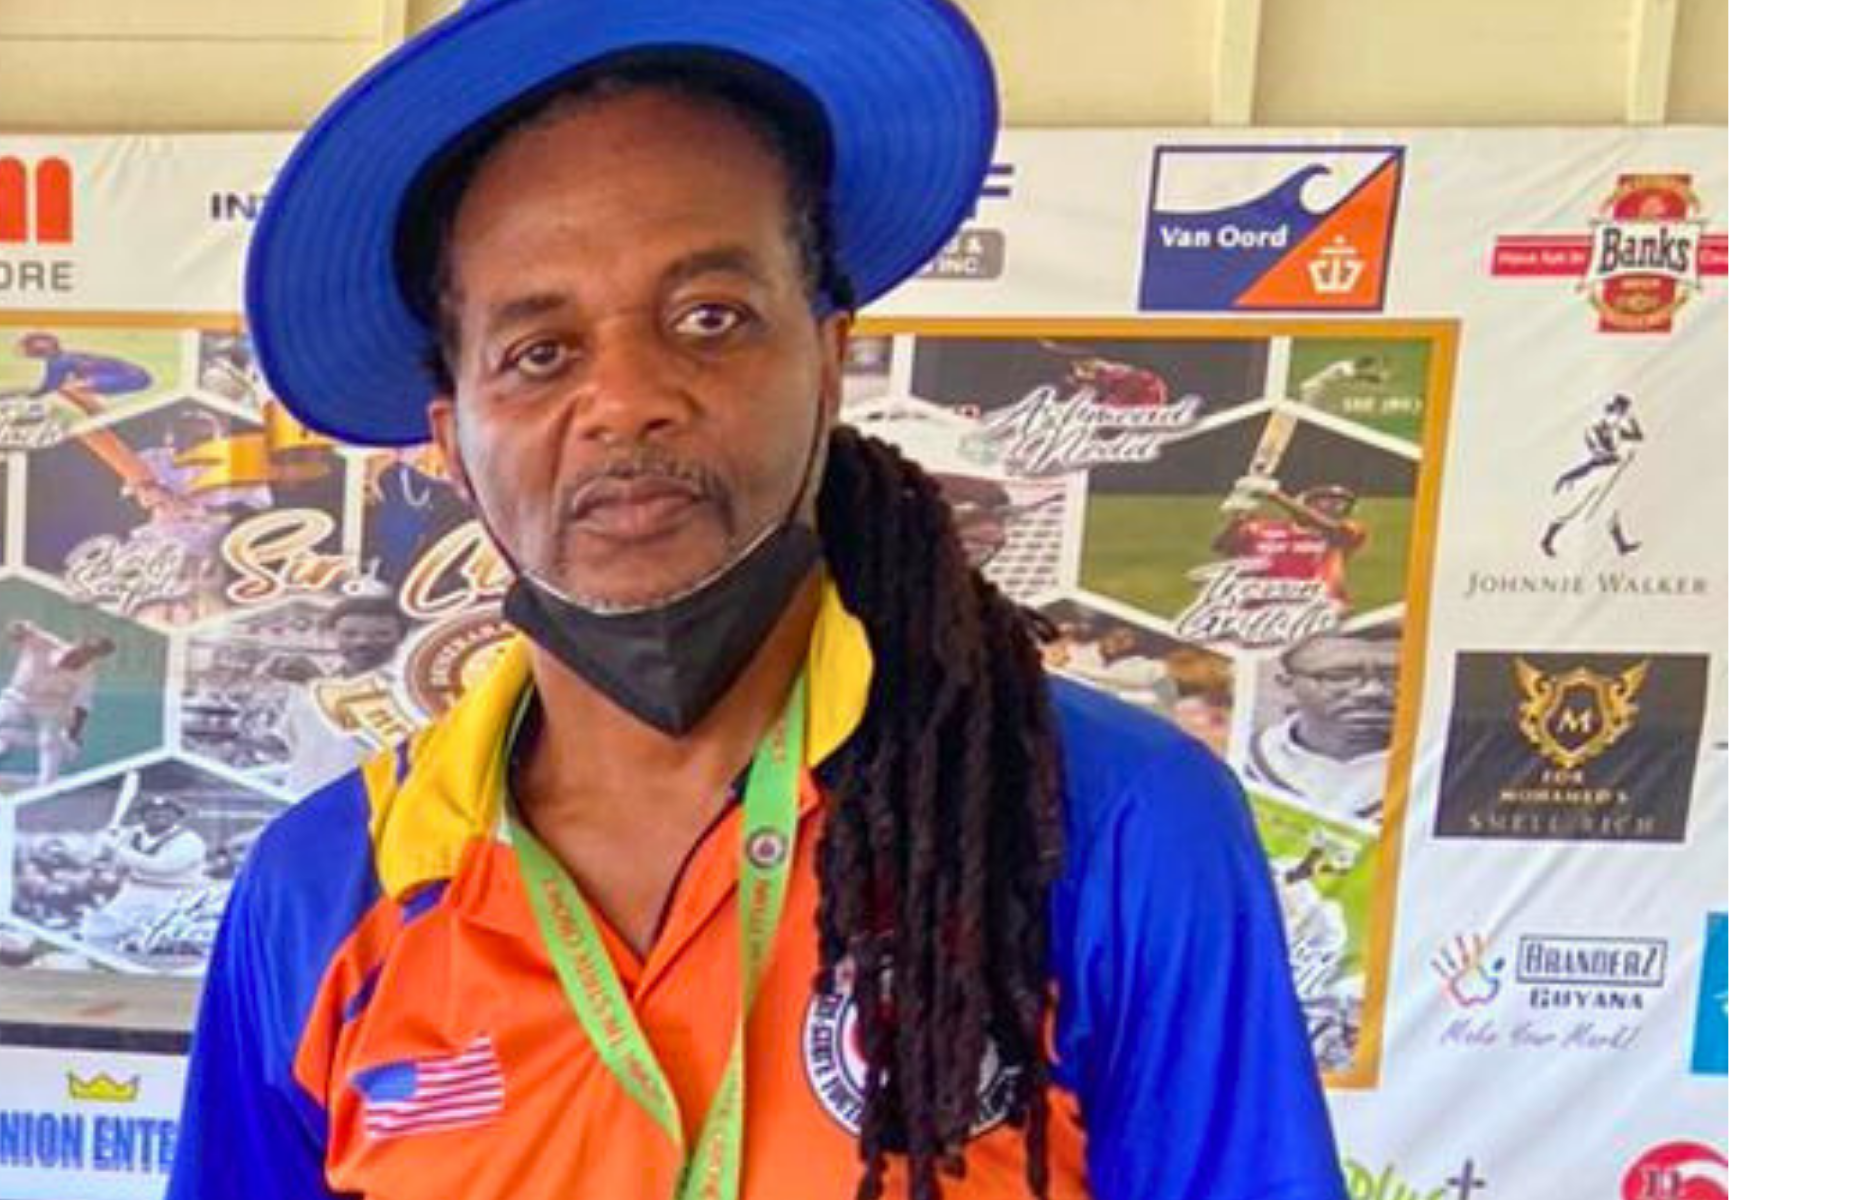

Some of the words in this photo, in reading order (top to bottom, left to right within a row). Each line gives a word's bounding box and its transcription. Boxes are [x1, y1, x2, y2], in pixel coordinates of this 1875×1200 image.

[1159, 224, 1212, 248] Van
[1217, 223, 1288, 248] Oord
[1598, 226, 1692, 276] Banks
[1465, 571, 1584, 598] JOHNNIE
[1529, 987, 1644, 1009] GUYANA
[92, 1115, 178, 1174] ENTE
